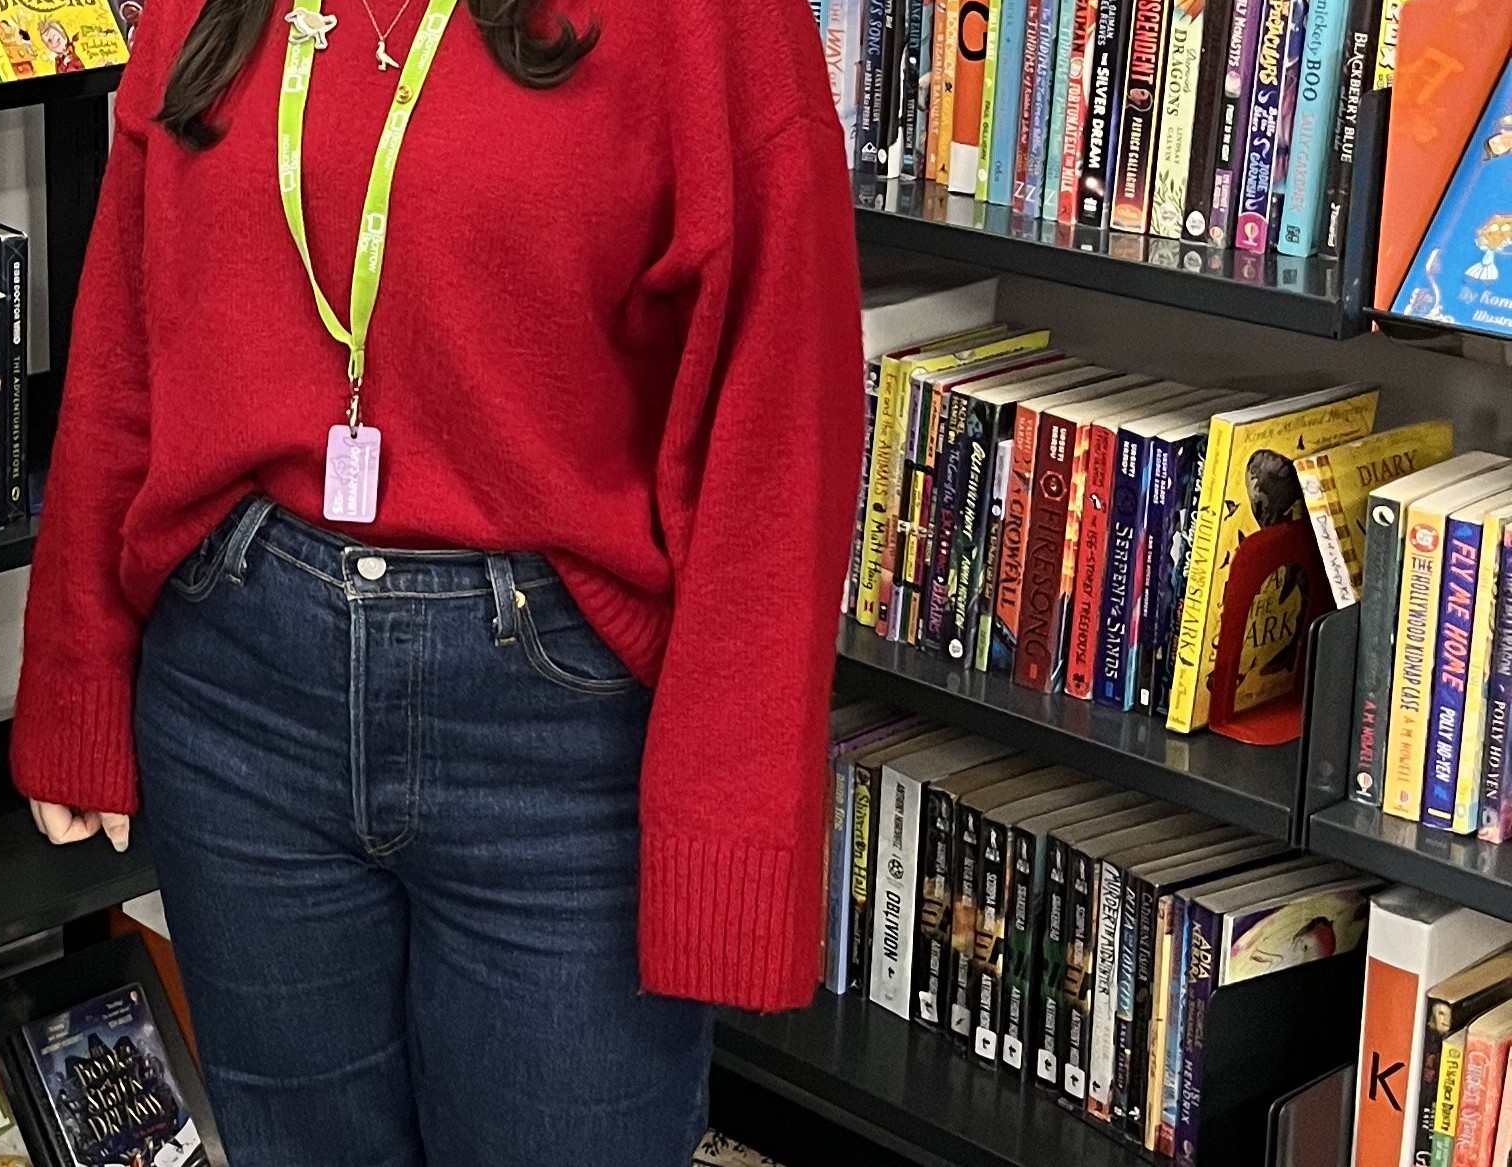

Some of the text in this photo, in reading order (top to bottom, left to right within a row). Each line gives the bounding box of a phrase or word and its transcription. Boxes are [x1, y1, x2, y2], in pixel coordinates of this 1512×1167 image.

[866, 19, 883, 55] SONG
[945, 10, 959, 77] BOOKSHOP
[1097, 13, 1109, 46] REAVES
[1105, 5, 1117, 39] GAIMAN
[826, 28, 844, 68] WAY
[1024, 20, 1038, 73] TINDIMS
[1037, 23, 1052, 75] TINDIMS
[1165, 28, 1188, 117] DRAGONS
[1301, 59, 1320, 101] BOO
[1343, 33, 1368, 123] BLACKBERRY
[1088, 68, 1110, 169] SILVER DREAM
[1129, 117, 1143, 150] PATRICK
[1289, 113, 1315, 212] SALLY GARDNER
[1339, 127, 1356, 163] BLUE
[1061, 167, 1076, 192] MILK
[1257, 162, 1270, 191] JODIE
[13, 285, 21, 319] DOCTOR
[12, 356, 21, 478] THE ADVENTURES BEFORE
[881, 420, 892, 436] the
[882, 396, 894, 417] and
[946, 395, 961, 445] HAMILTON
[955, 398, 969, 435] RACHEL
[1016, 416, 1027, 450] HARDY
[1023, 419, 1033, 454] VASHTI
[1049, 425, 1059, 459] HARDY
[873, 438, 891, 496] ANIMALS
[969, 442, 986, 472] ORLA
[1121, 440, 1131, 475] HARDY
[1356, 450, 1419, 486] DIARY
[870, 519, 885, 554] Matt
[961, 508, 977, 541] HUNT
[1192, 515, 1214, 565] JULIA
[862, 560, 882, 591] Haig
[958, 555, 972, 580] ANNA
[1000, 499, 1024, 609] CROWFALL
[1025, 507, 1062, 660] FIRESONG
[1105, 522, 1133, 678] SERPENT SANDS
[929, 583, 948, 633] BRAINS
[1177, 585, 1203, 657] SHARK
[1442, 540, 1475, 691] FLY ME HOME
[1075, 602, 1093, 665] TREEHOUSE
[1399, 556, 1433, 712] THE HOLLYWOOD KIDNAP CASE
[1358, 726, 1375, 771] HOWELL
[1396, 716, 1416, 784] A M HOWELL
[1435, 707, 1457, 782] POLLY HO-YEN
[1486, 701, 1506, 800] POLLY HO-YEN
[853, 793, 869, 897] Shiverton Hall
[1102, 868, 1122, 923] MURDER
[1124, 887, 1136, 929] DELTA
[882, 891, 901, 962] OBLIVION
[1137, 893, 1153, 982] CATHERINE FISHER
[1098, 935, 1117, 996] MIDWINTER
[1122, 945, 1133, 978] LOST
[1197, 937, 1213, 979] ADIA
[1120, 981, 1133, 1014] CITY
[1180, 1059, 1194, 1125] HENDRIX
[1191, 1088, 1202, 1108] ISI
[1368, 1051, 1406, 1112] K
